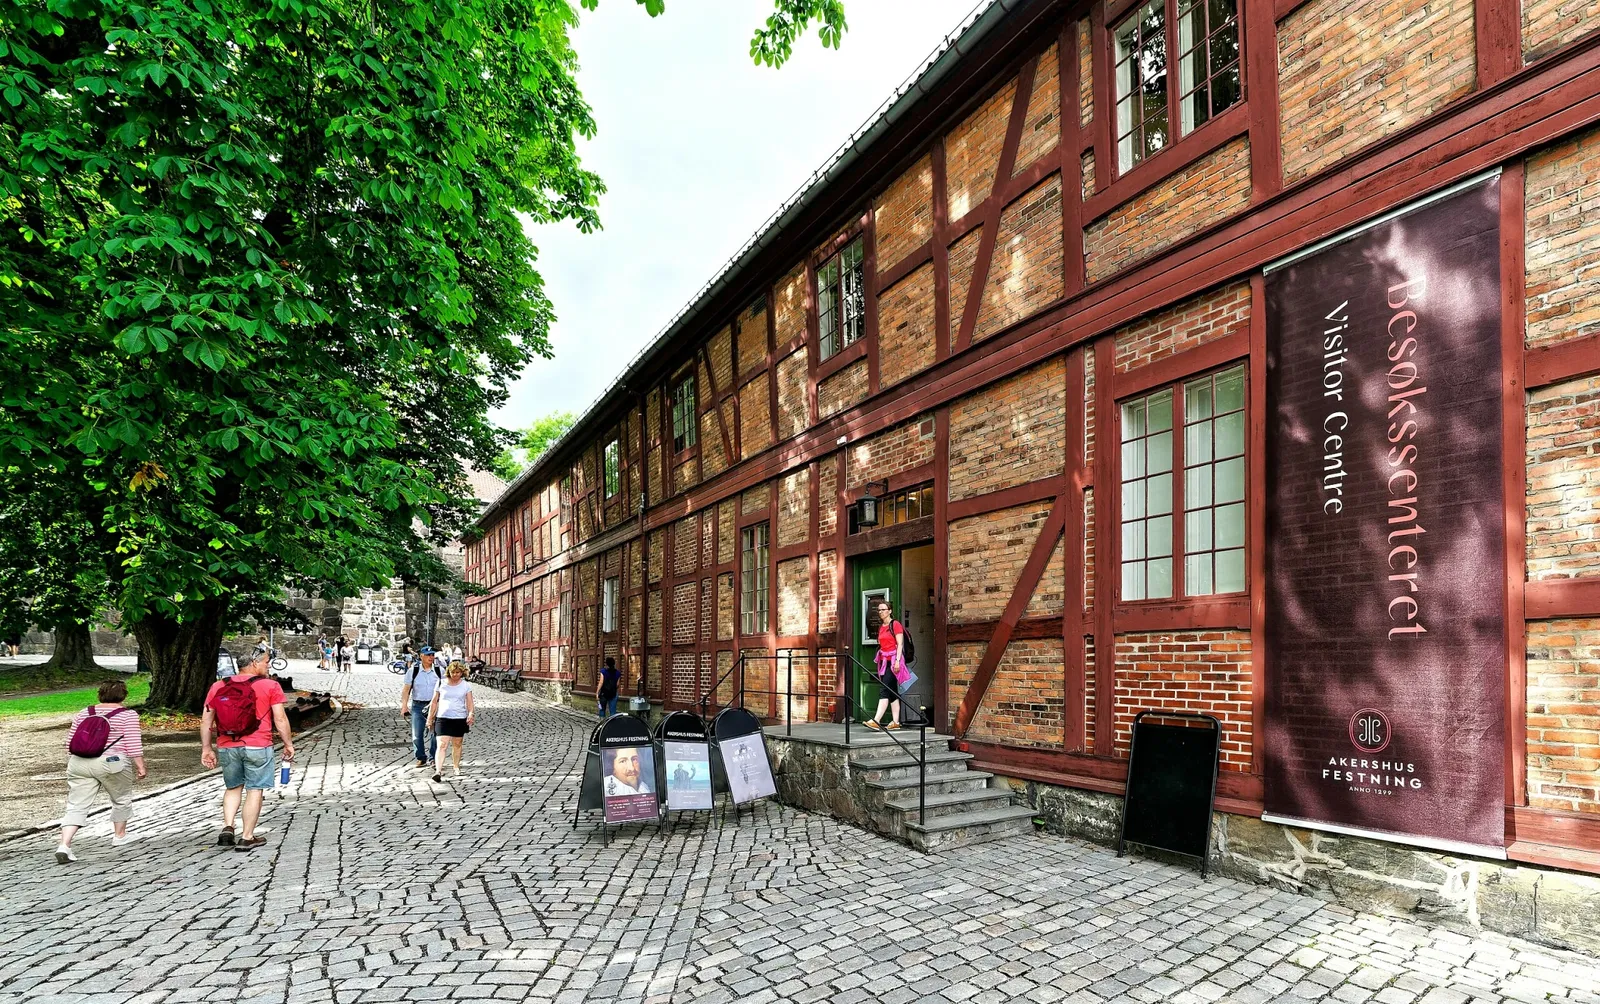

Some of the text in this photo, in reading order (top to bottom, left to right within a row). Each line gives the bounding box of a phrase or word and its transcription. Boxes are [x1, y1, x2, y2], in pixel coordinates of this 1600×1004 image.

[1323, 299, 1349, 516] Visitor Centre
[1385, 275, 1427, 642] Besøkssenteret
[1328, 756, 1415, 773] AKERSHUS
[1322, 769, 1423, 789] FESTNING
[1349, 785, 1392, 796] ANNO 1299
